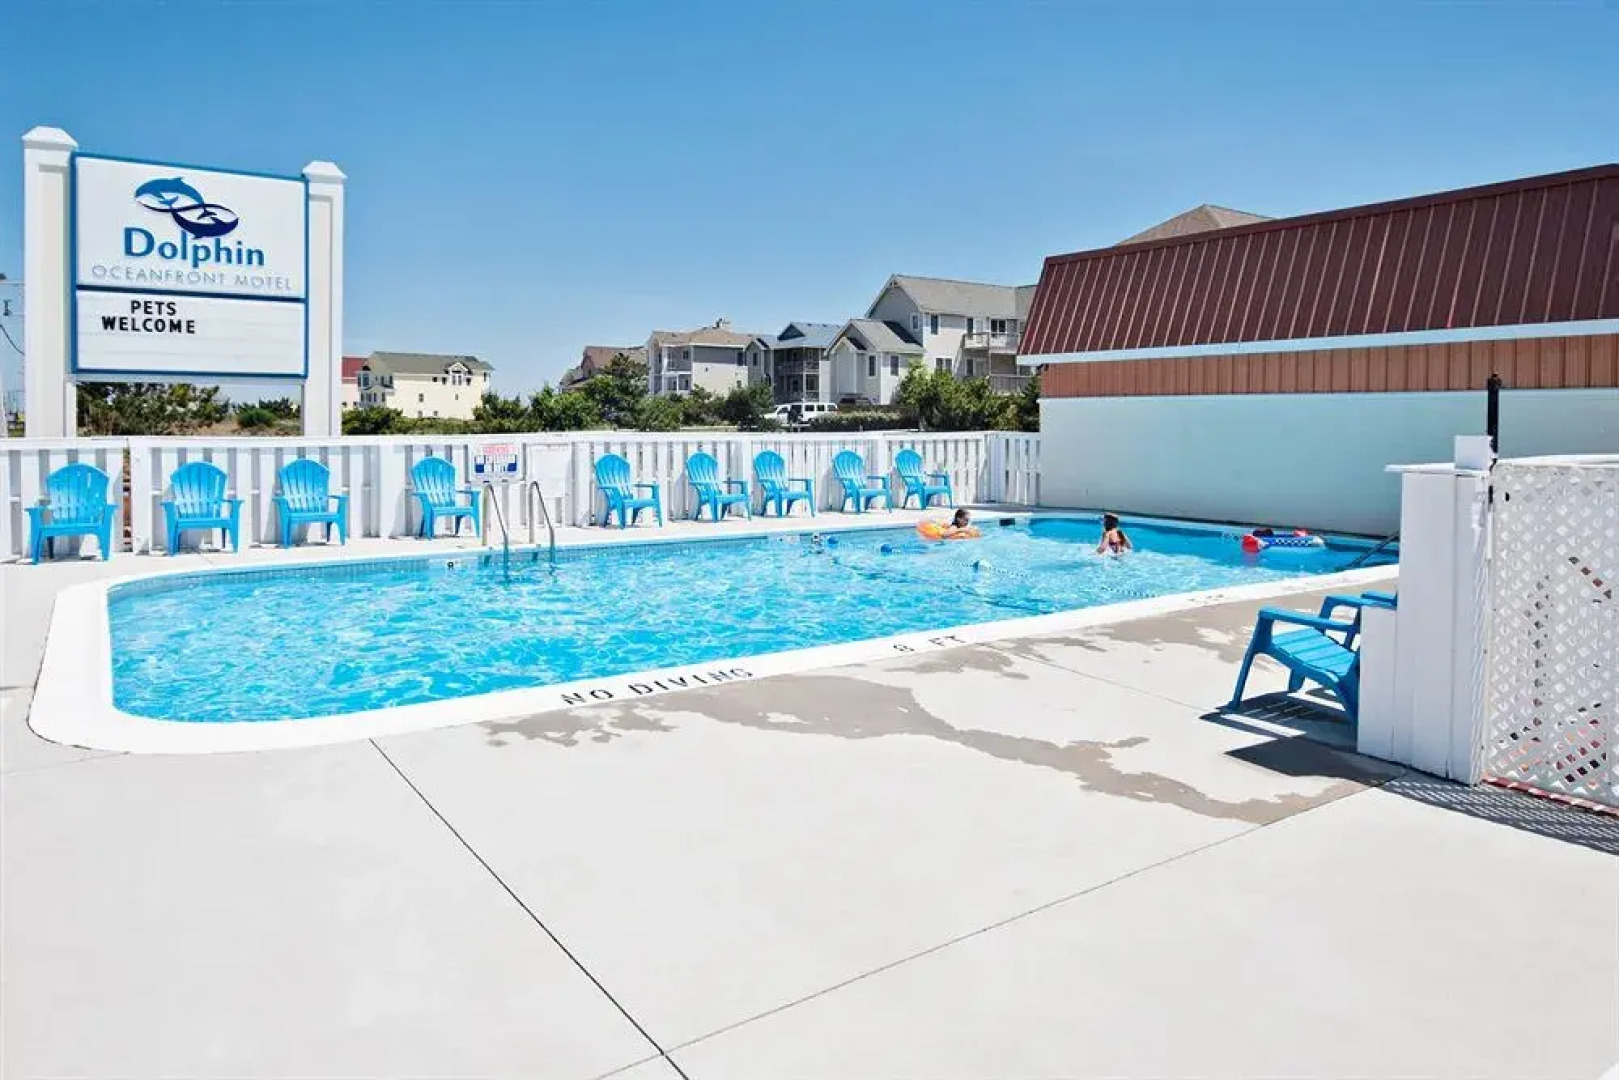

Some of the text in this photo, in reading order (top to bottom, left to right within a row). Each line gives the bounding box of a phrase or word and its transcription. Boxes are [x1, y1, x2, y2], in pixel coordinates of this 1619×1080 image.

[123, 226, 265, 268] Dolphin
[91, 264, 293, 290] OCEANFRONT MOTEL
[130, 300, 177, 316] PETS
[101, 316, 196, 334] WELCOME
[928, 635, 966, 647] FT
[560, 667, 754, 705] NO DIVING
